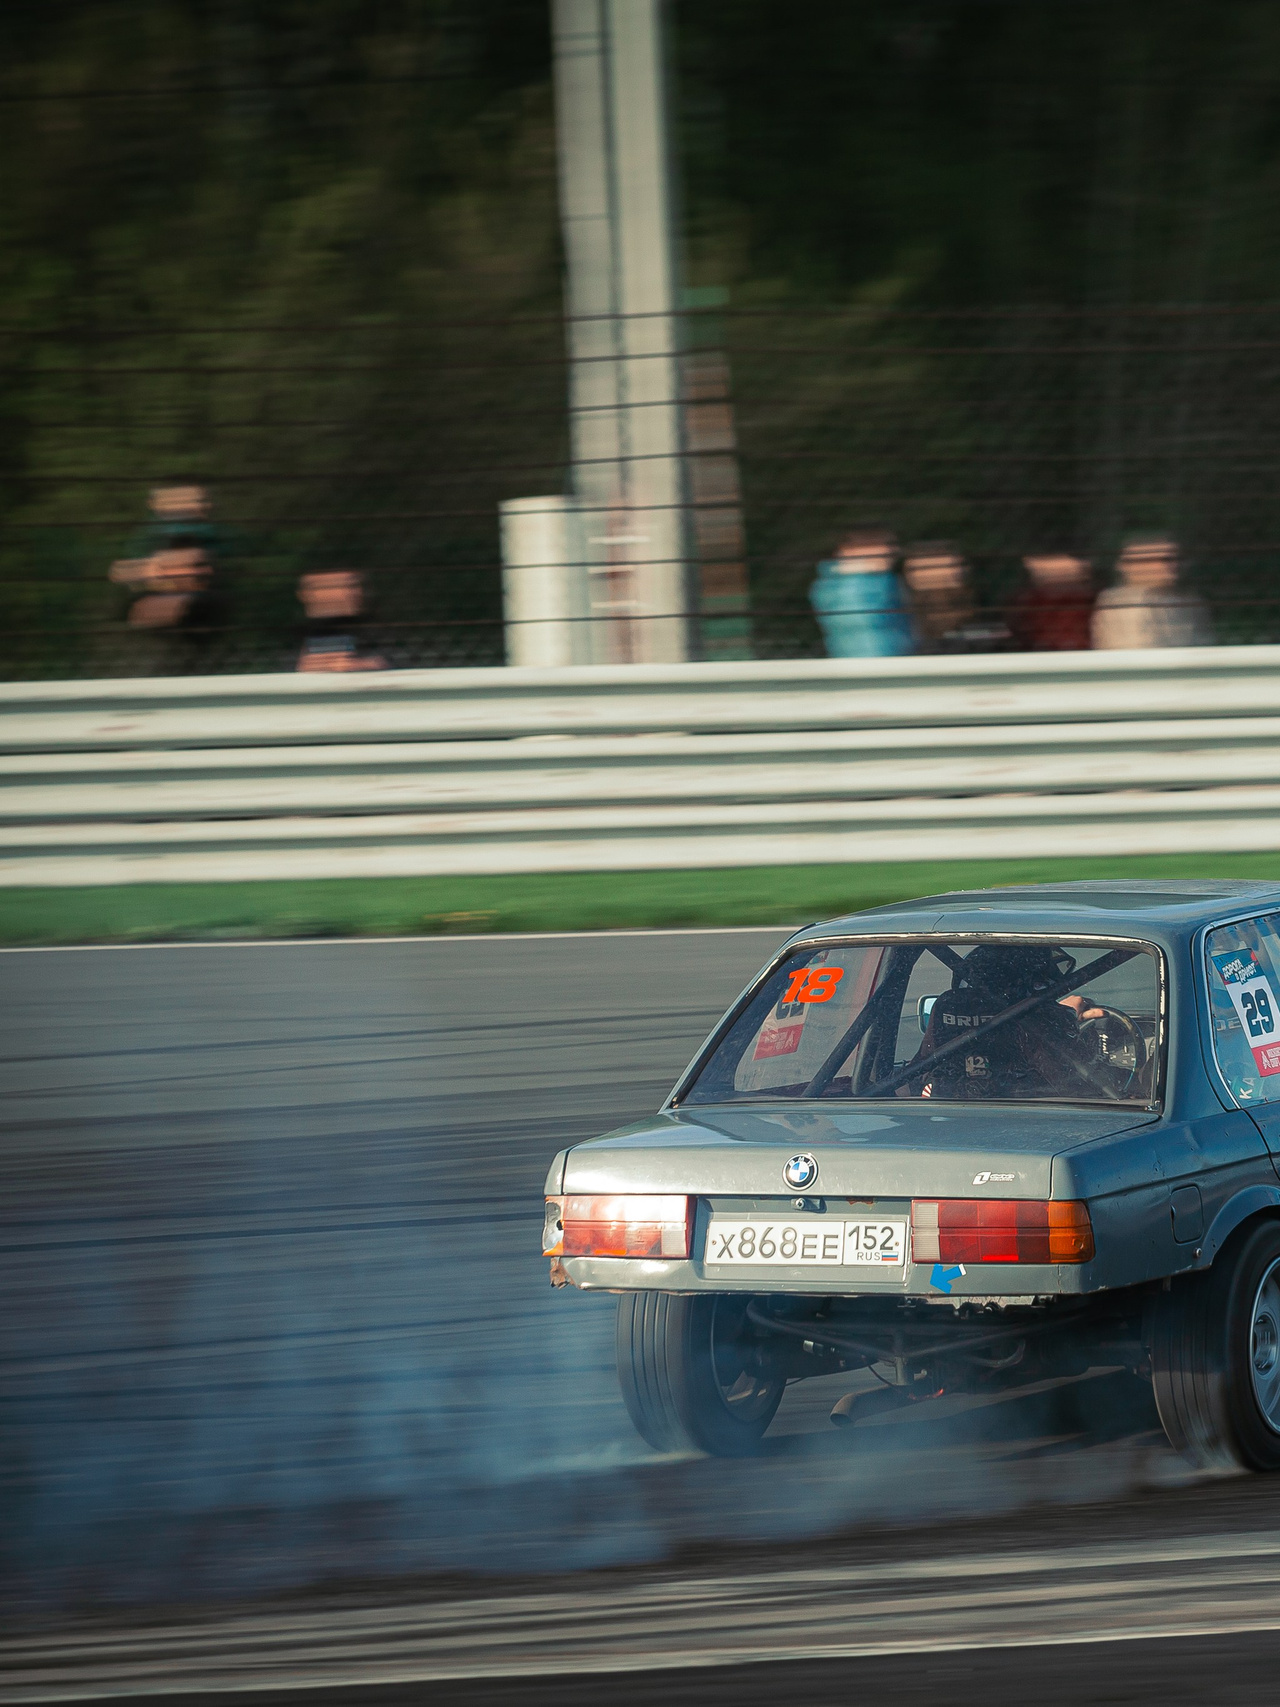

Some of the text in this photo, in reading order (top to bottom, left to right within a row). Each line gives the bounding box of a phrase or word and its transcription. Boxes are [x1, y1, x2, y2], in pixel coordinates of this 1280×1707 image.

[782, 967, 844, 1003] 18
[1241, 988, 1274, 1038] 29
[848, 1225, 894, 1251] 152
[856, 1251, 881, 1261] RUS
